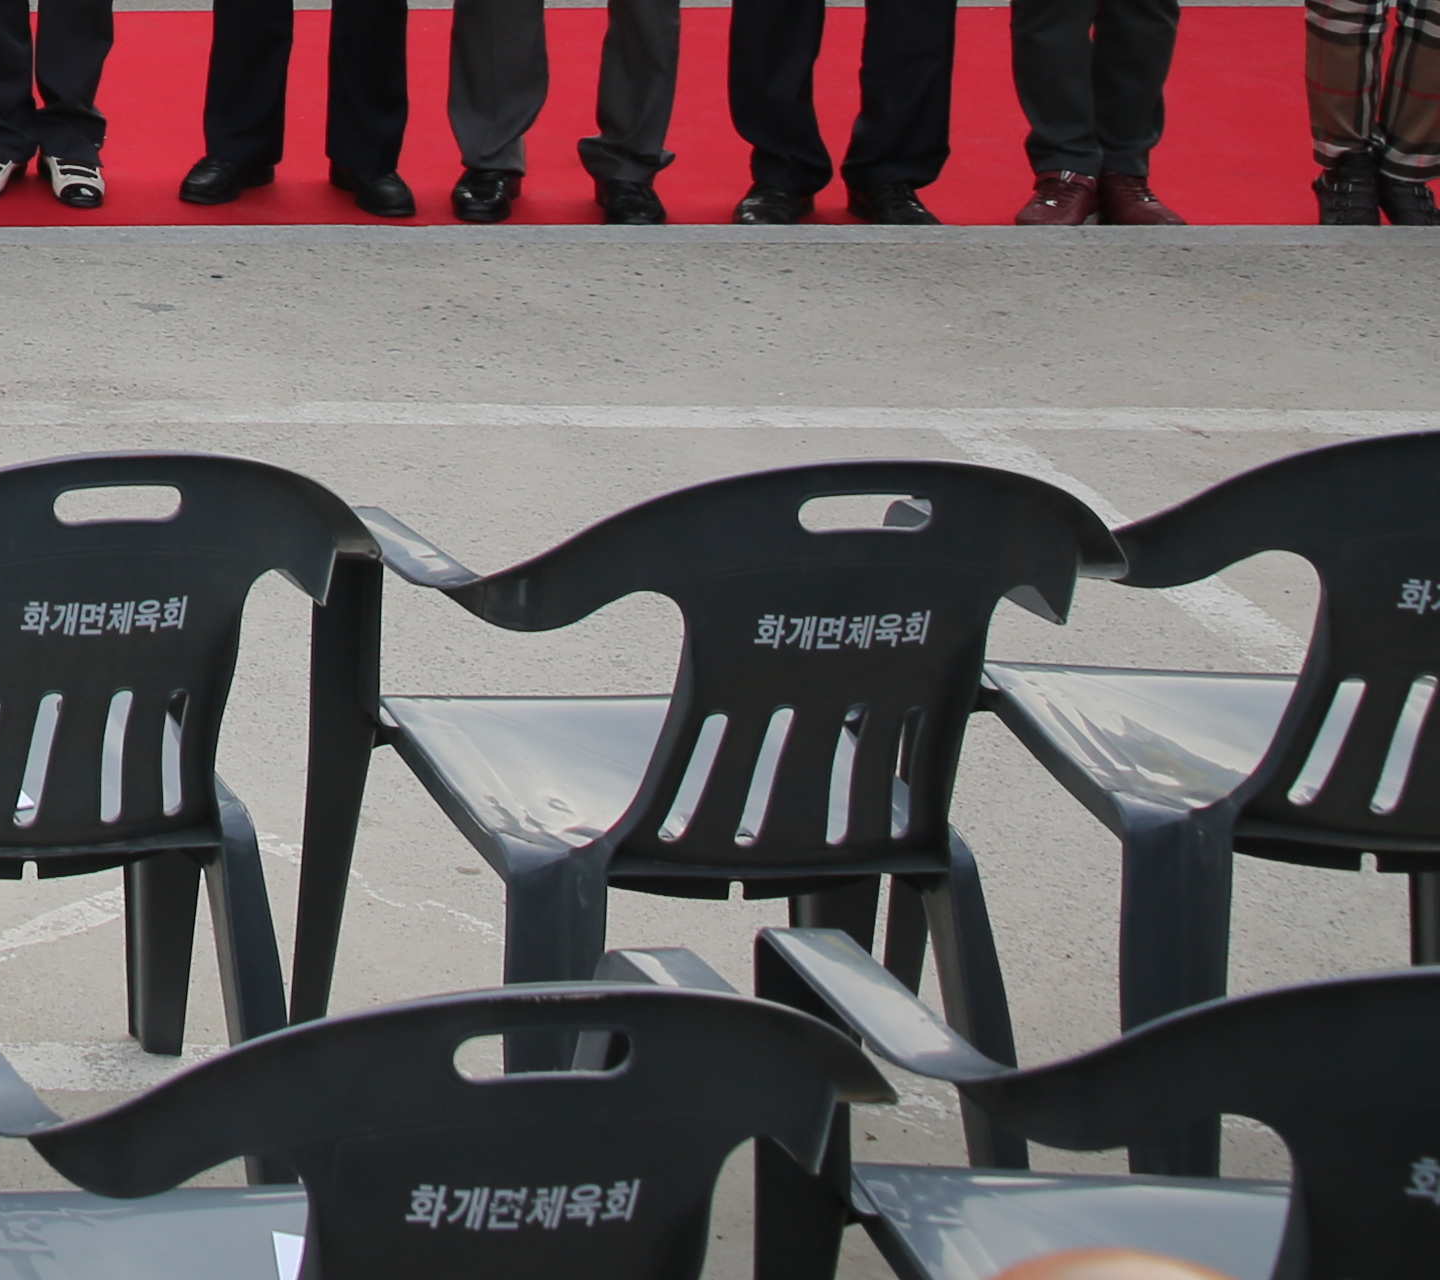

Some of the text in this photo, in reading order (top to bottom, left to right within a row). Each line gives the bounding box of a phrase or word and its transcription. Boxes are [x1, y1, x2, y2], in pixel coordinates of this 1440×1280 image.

[20, 595, 189, 636] 화개면체육회
[753, 609, 932, 651] 화개면체육회
[404, 1178, 642, 1231] 화개면체육회
